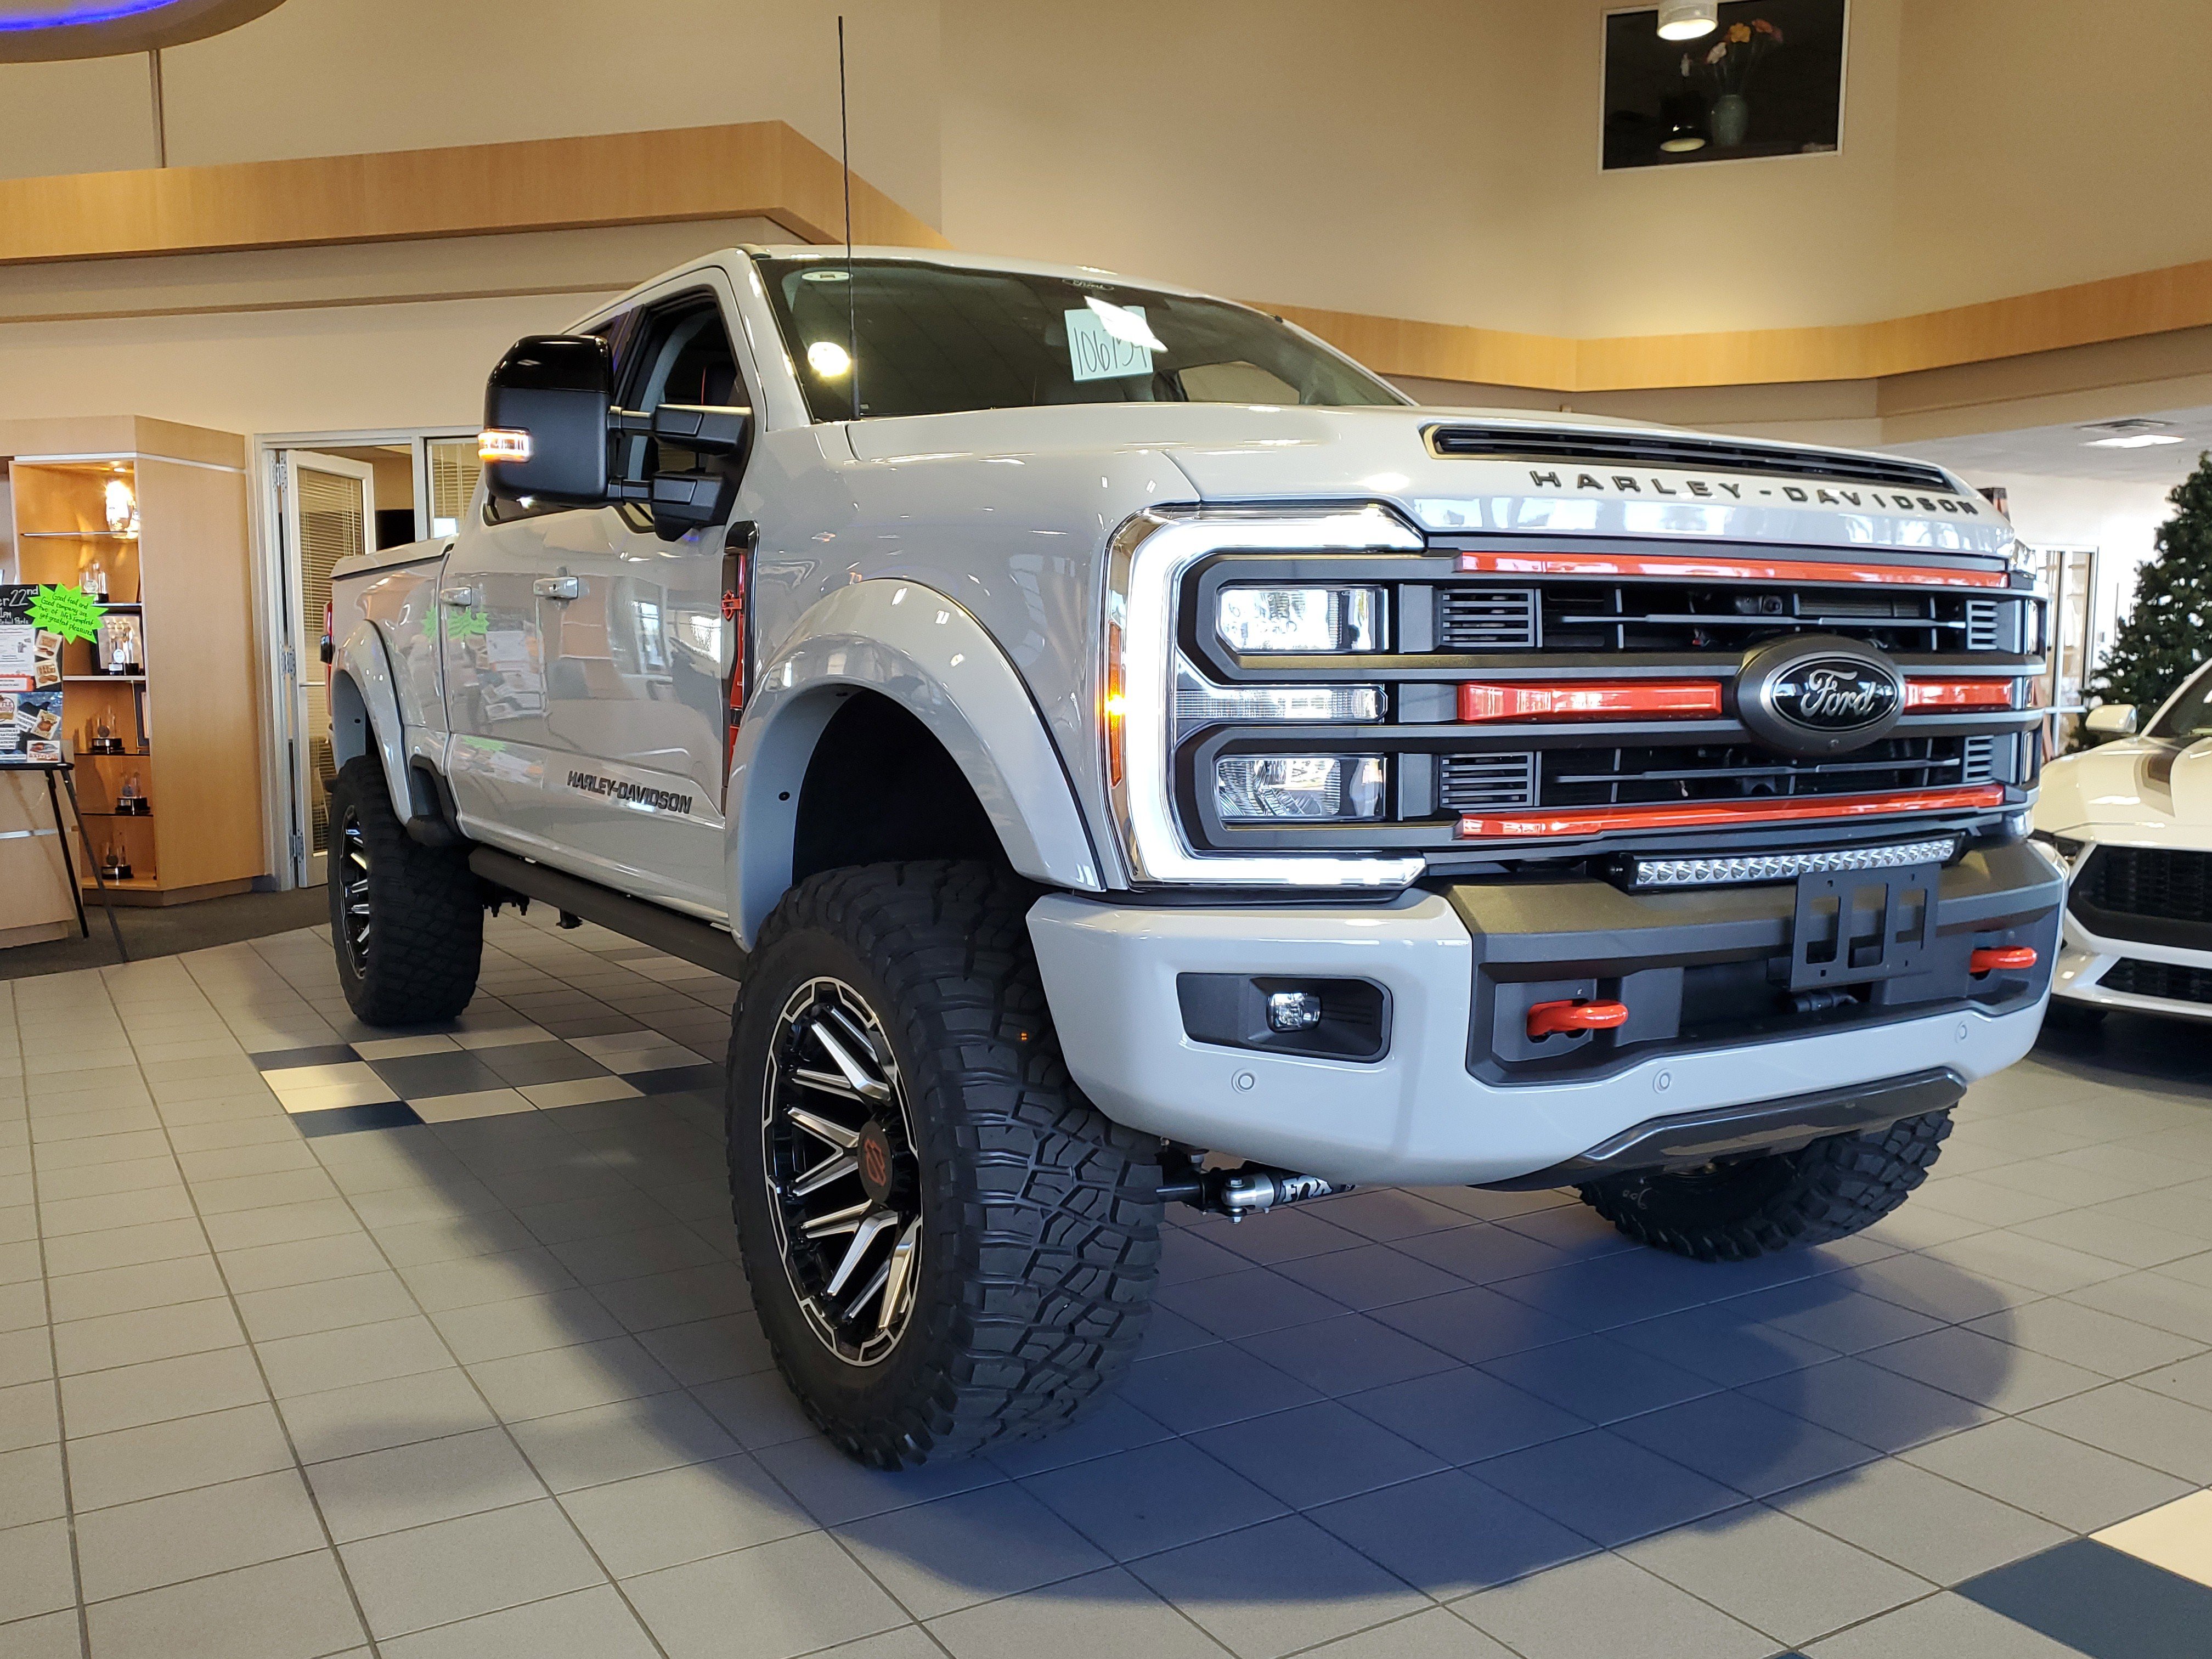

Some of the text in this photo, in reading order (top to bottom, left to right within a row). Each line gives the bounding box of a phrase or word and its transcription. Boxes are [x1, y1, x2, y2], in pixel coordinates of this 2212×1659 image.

[9, 585, 39, 607] 22nd
[41, 596, 55, 606] Good
[56, 603, 78, 616] company
[52, 593, 66, 602] Good
[67, 597, 79, 606] food
[1801, 669, 1876, 718] Ford
[567, 770, 692, 814] HARLEY-DAVIDSON
